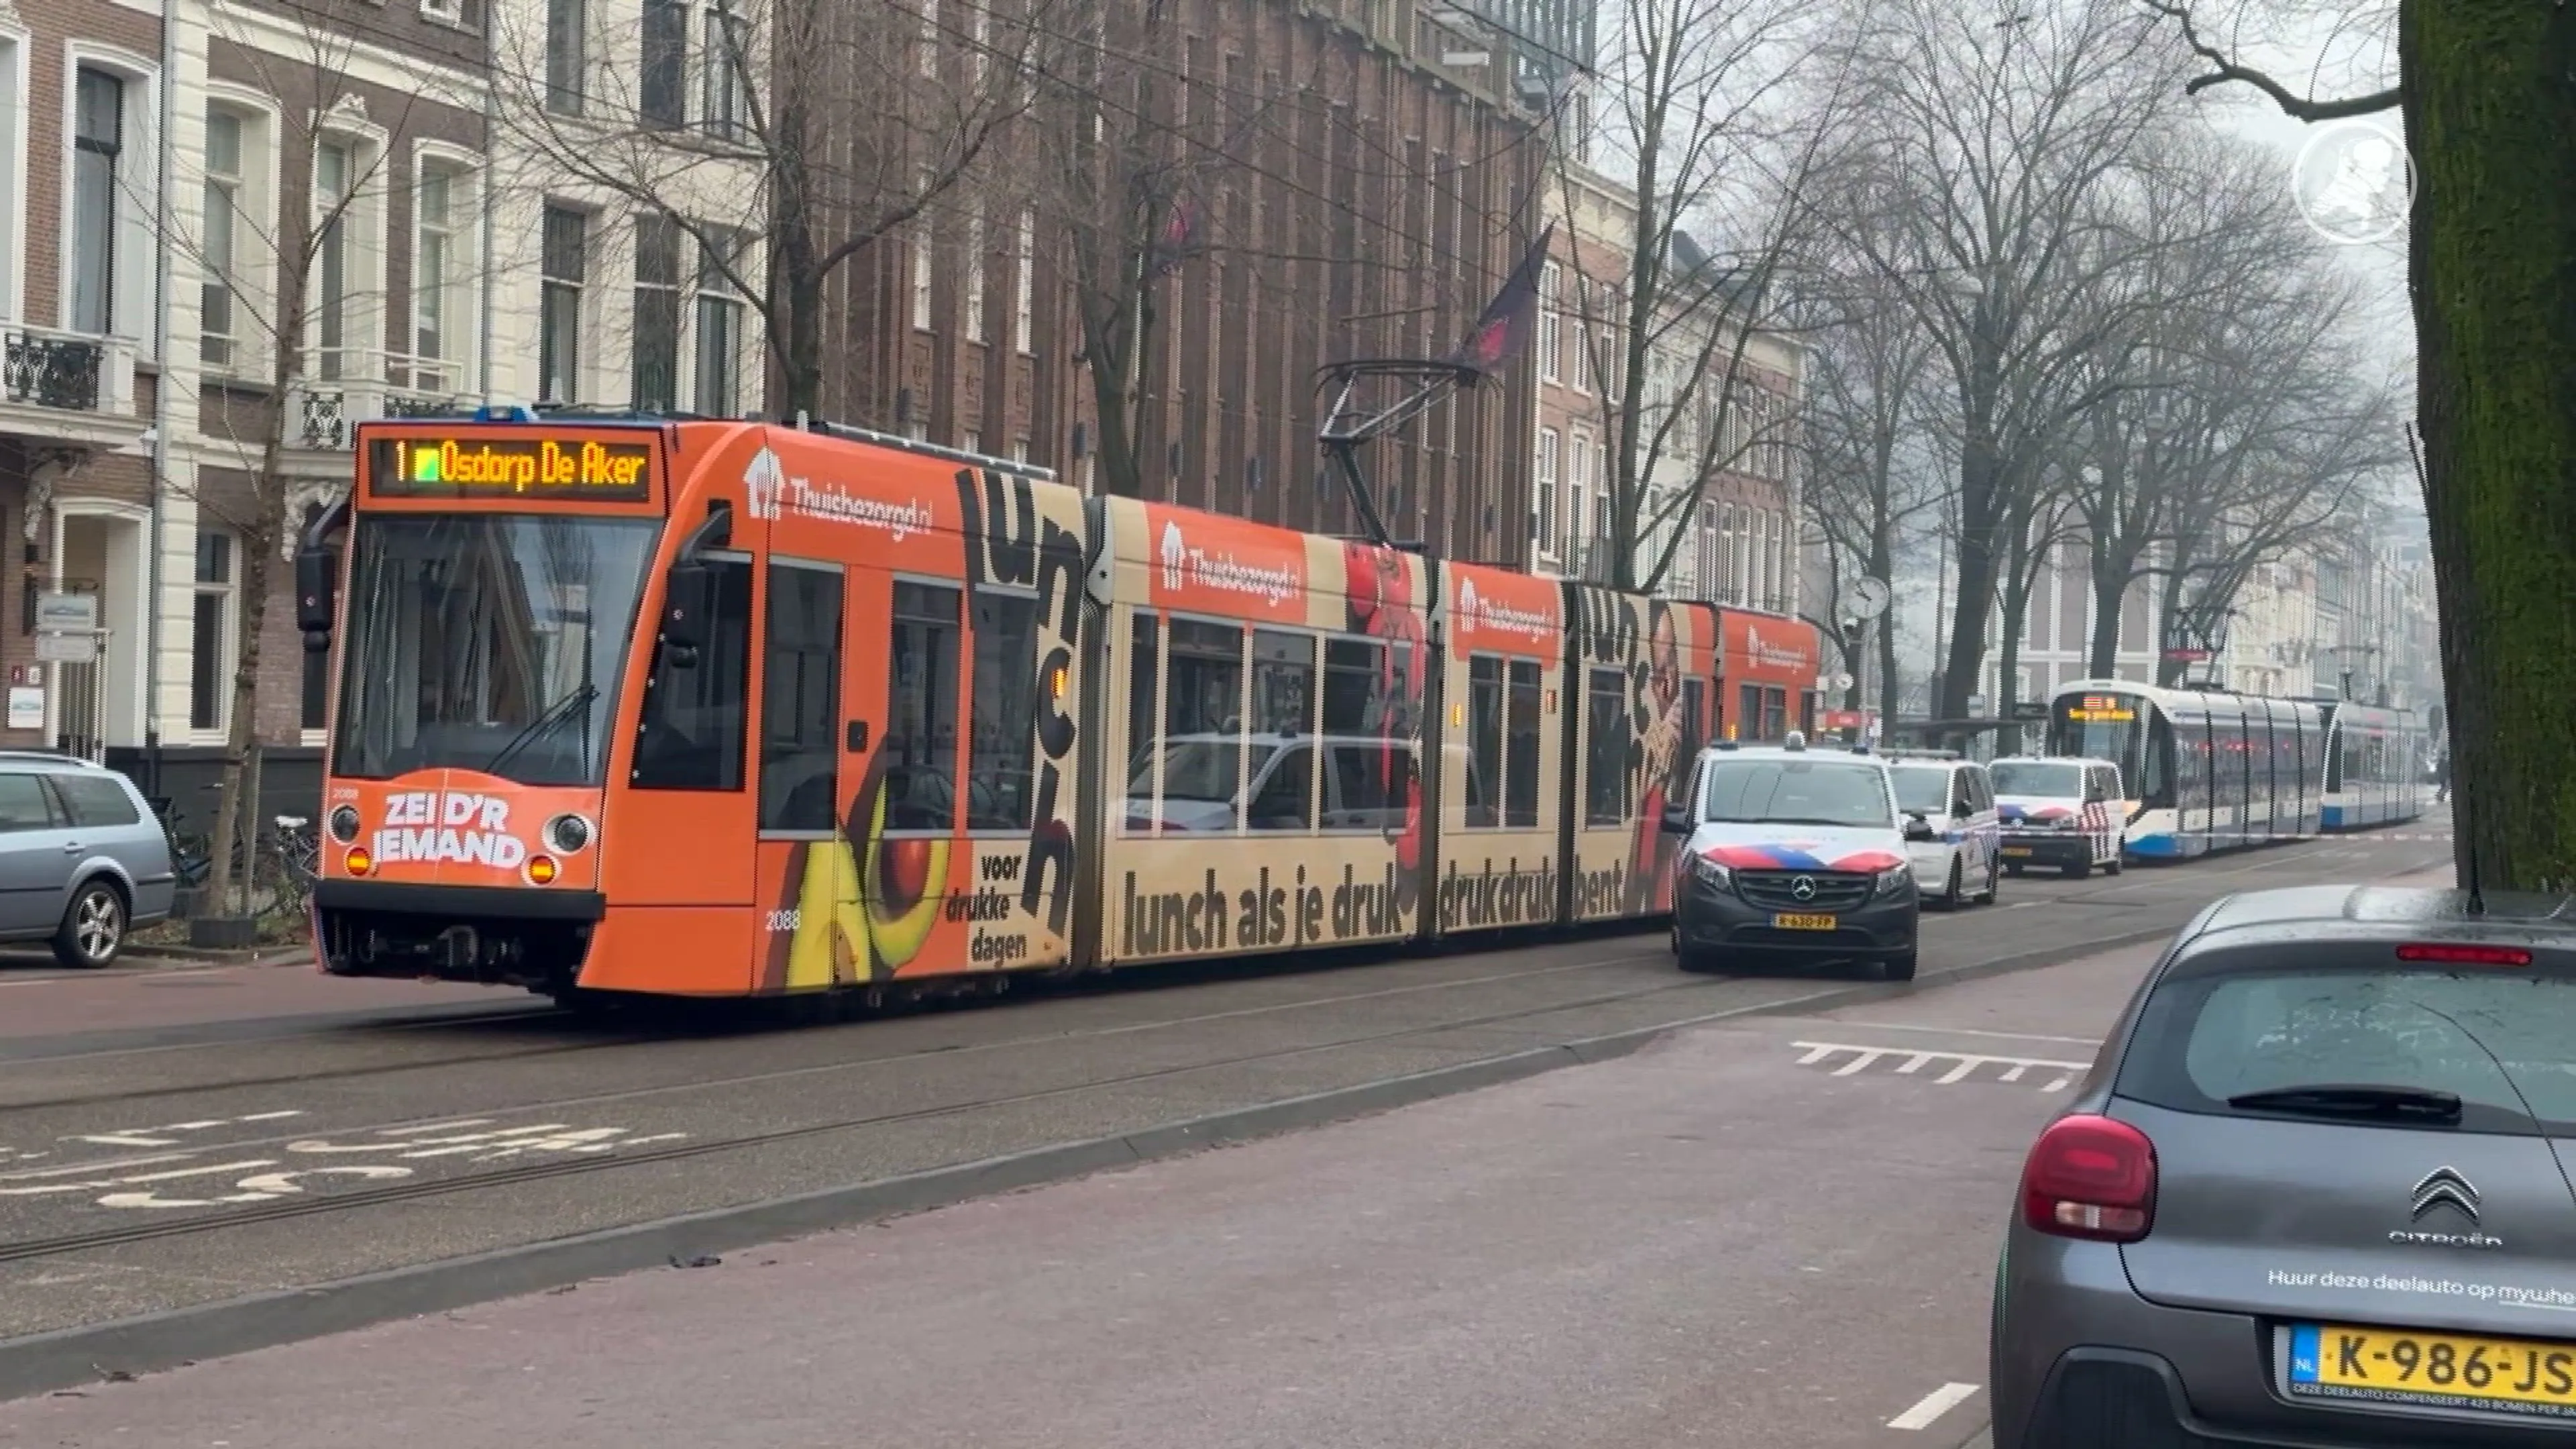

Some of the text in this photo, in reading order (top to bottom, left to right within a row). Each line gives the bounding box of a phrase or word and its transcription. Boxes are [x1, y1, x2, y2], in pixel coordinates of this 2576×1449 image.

[396, 440, 645, 491] 1 Osdorp De Aker
[386, 792, 437, 825] ZEI
[981, 855, 1022, 881] voor
[765, 910, 801, 930] 2088
[946, 886, 1011, 922] drukke
[1123, 868, 1228, 956] lunch
[1237, 866, 1287, 947] als
[1295, 864, 1324, 945] je
[1332, 862, 1403, 940] druk
[972, 927, 1027, 969] dagen
[2268, 1270, 2316, 1286] Huur
[2320, 1271, 2369, 1289] deze
[2373, 1273, 2464, 1295] deelauto
[2467, 1284, 2495, 1301] op
[2296, 1358, 2314, 1373] NL
[2339, 1335, 2575, 1395] K-986-JS
[2293, 1383, 2322, 1395] DEZE
[2324, 1385, 2382, 1401] DEELAUTO
[2492, 1400, 2537, 1413] BOMEN
